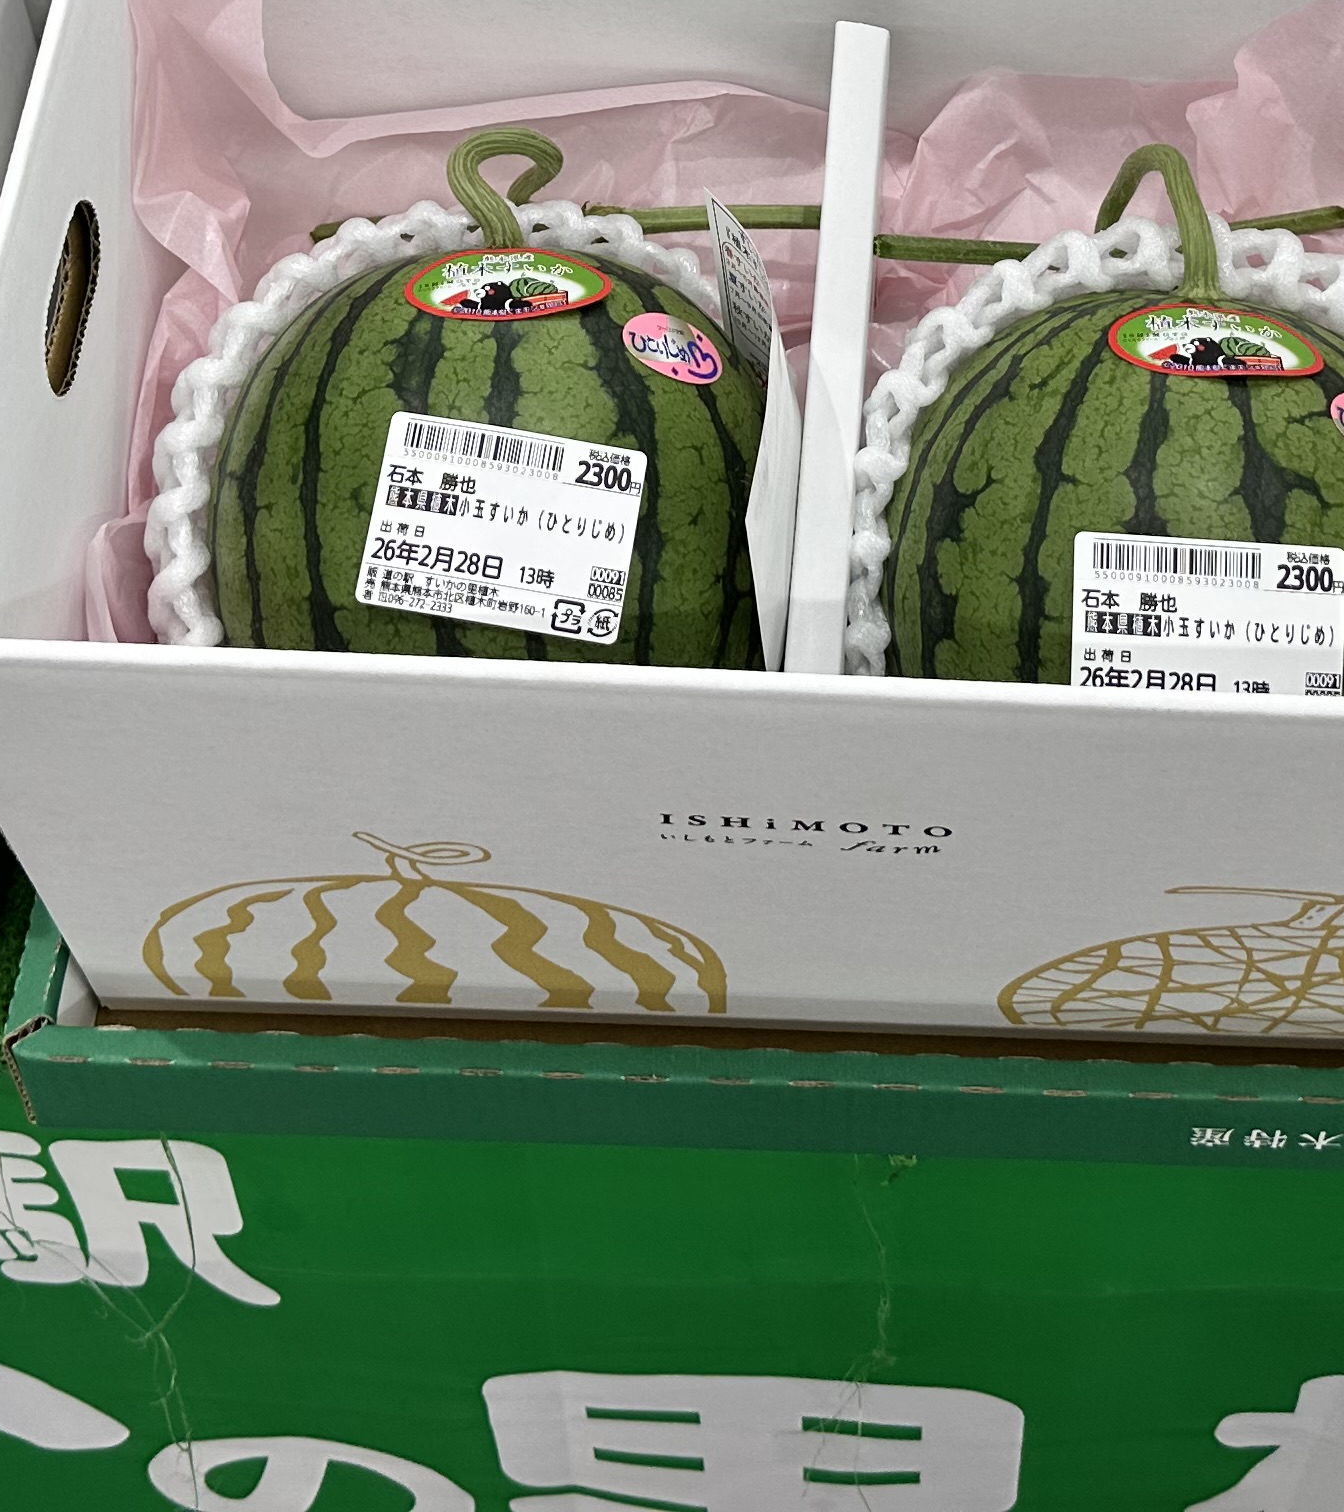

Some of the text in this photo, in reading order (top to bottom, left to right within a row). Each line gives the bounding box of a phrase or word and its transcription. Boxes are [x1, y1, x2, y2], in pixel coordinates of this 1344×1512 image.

[589, 448, 631, 466] 税込価格
[387, 464, 476, 494] 石本 勝也
[575, 460, 642, 495] 2300円
[380, 519, 426, 538] 出荷日
[371, 537, 625, 589] 26年2月28日 13時 00091
[1287, 551, 1331, 565] 税込価格
[1276, 564, 1344, 594] 2300円
[587, 583, 623, 602] 00085
[1082, 588, 1178, 613] 石本 勝也
[1083, 647, 1132, 663] 出荷日
[1079, 666, 1216, 692] 26年2月28日
[1305, 672, 1341, 689] 00091
[840, 840, 942, 855] farm
